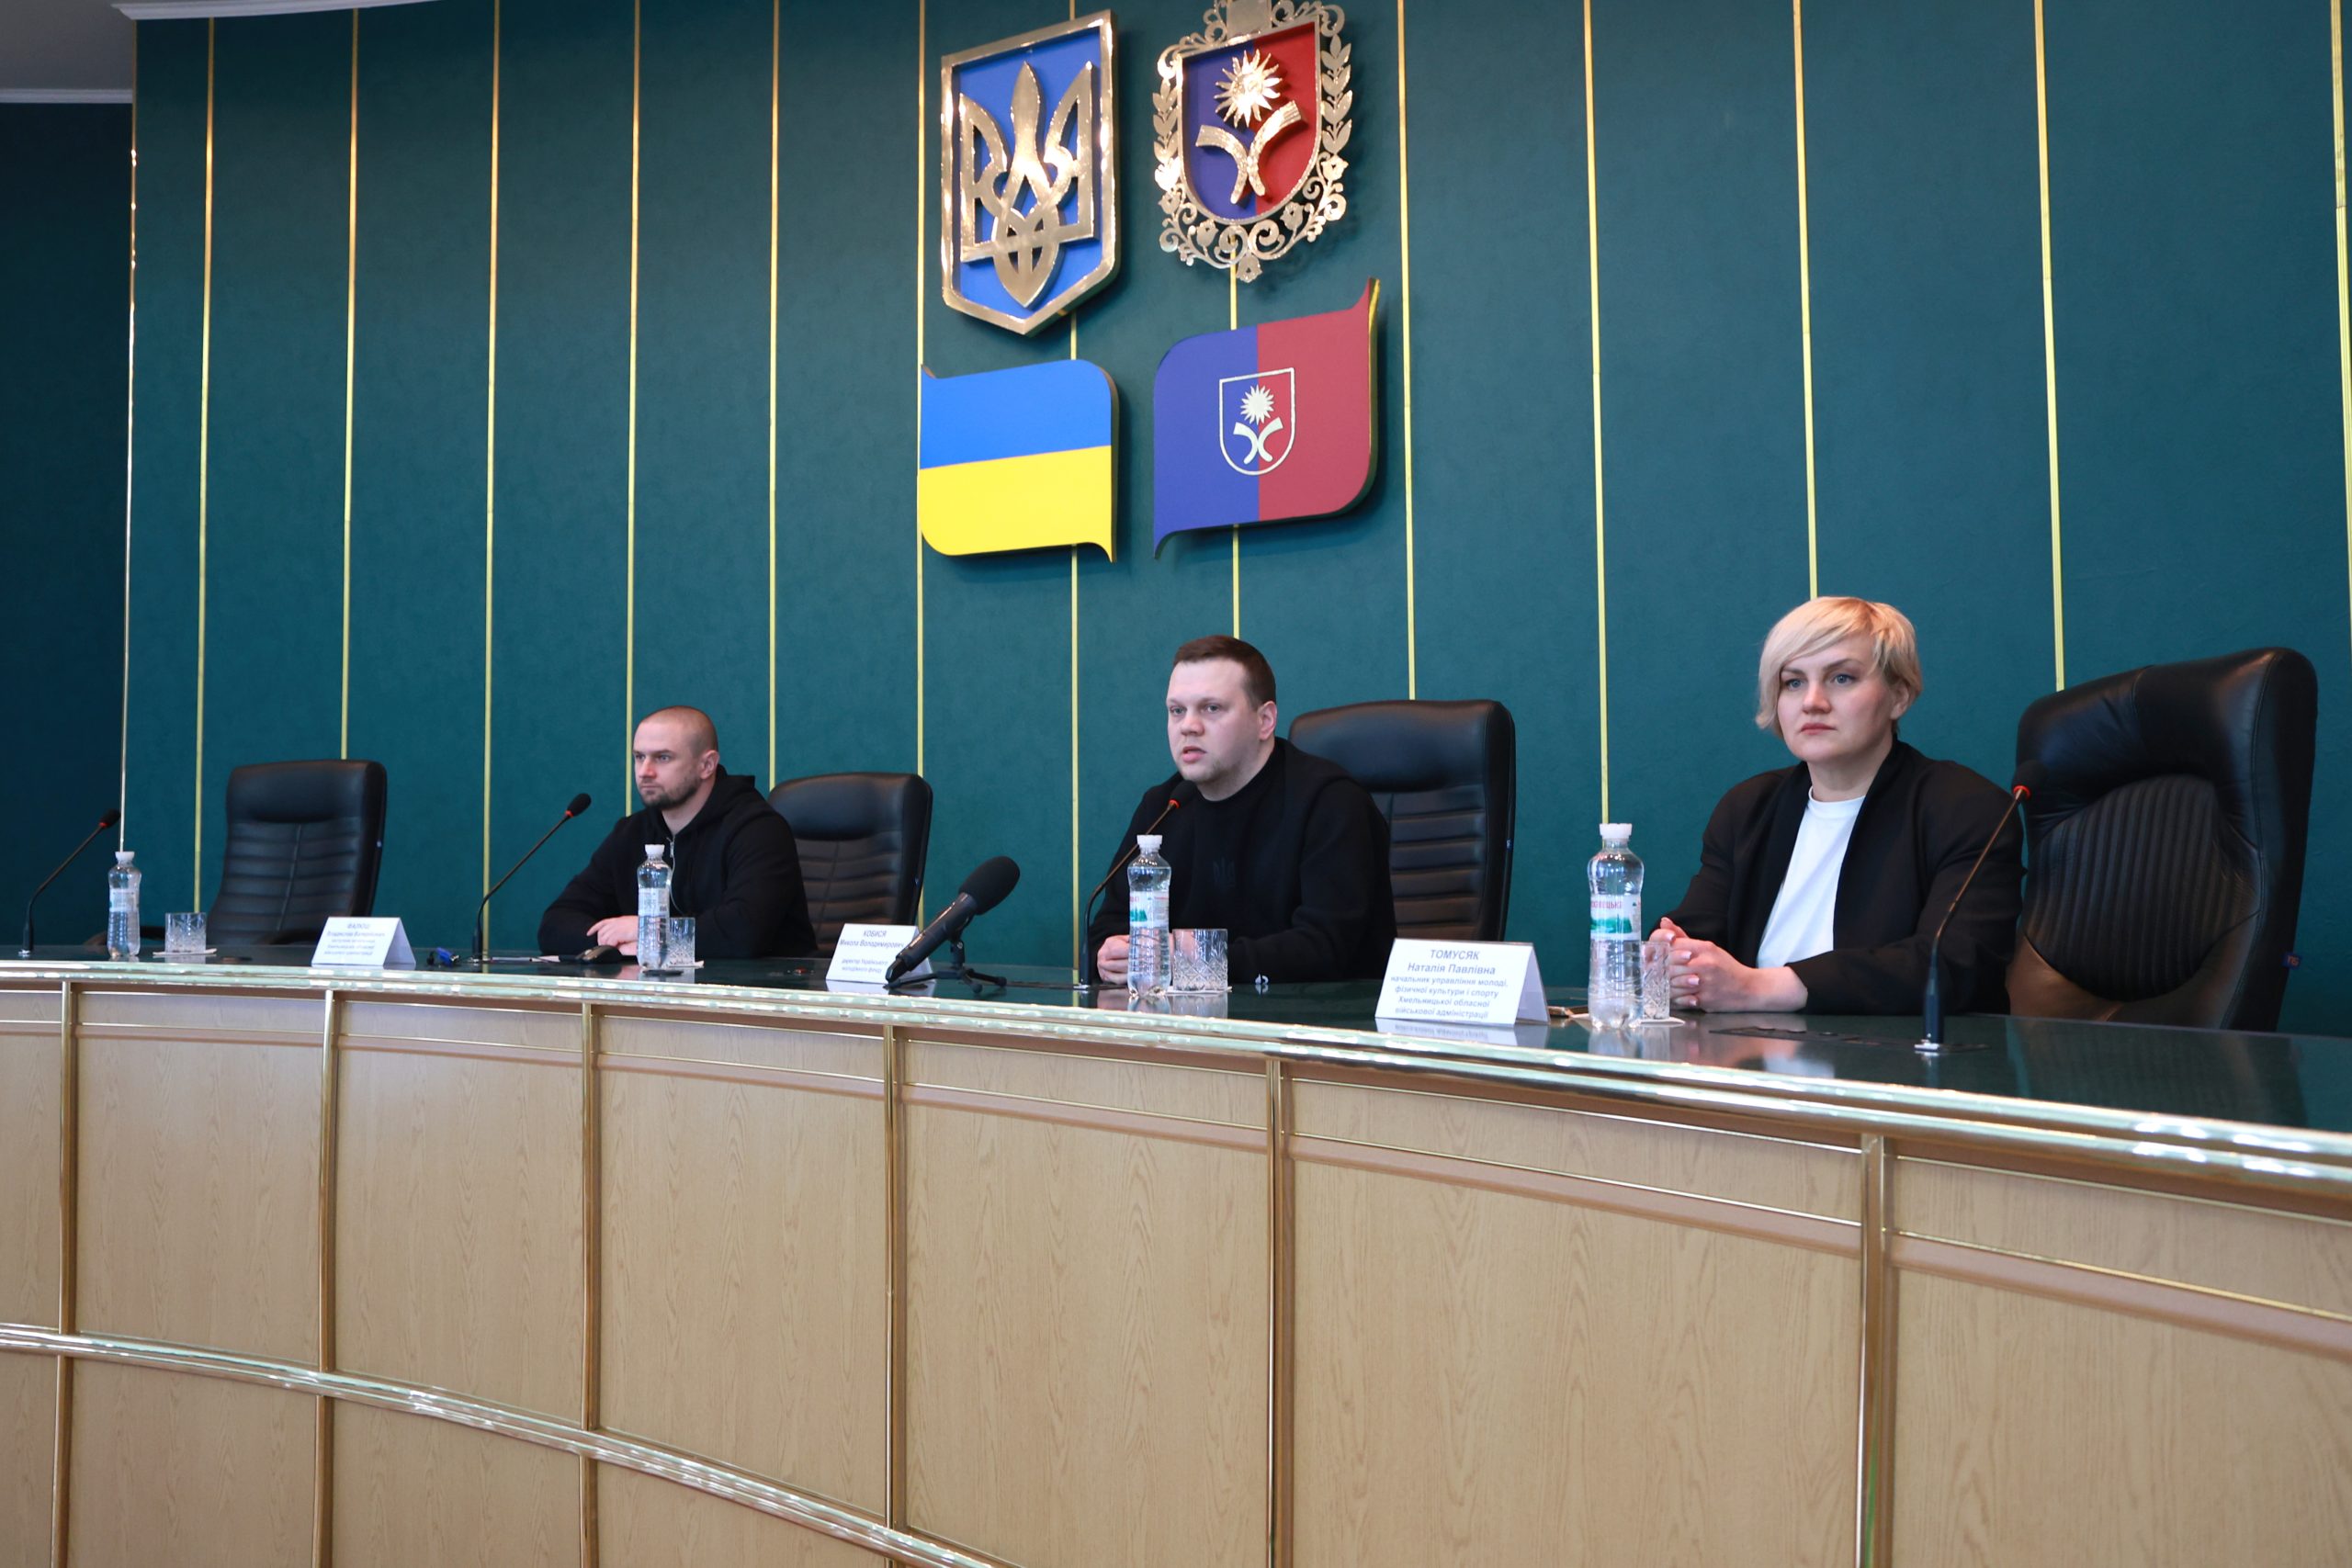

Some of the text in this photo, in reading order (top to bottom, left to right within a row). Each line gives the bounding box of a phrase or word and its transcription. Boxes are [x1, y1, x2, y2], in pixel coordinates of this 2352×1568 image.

[1430, 950, 1481, 961] ТОМУСЯК
[1408, 962, 1496, 976] Наталія Павлівна
[1390, 976, 1430, 984] начальник
[1431, 977, 1476, 986] управління
[1395, 986, 1428, 995] фізичної
[1429, 987, 1465, 997] культури
[1471, 989, 1499, 999] спорту
[1397, 996, 1490, 1008] Хмельницької обласної
[1395, 1007, 1489, 1020] військової адміністрації
